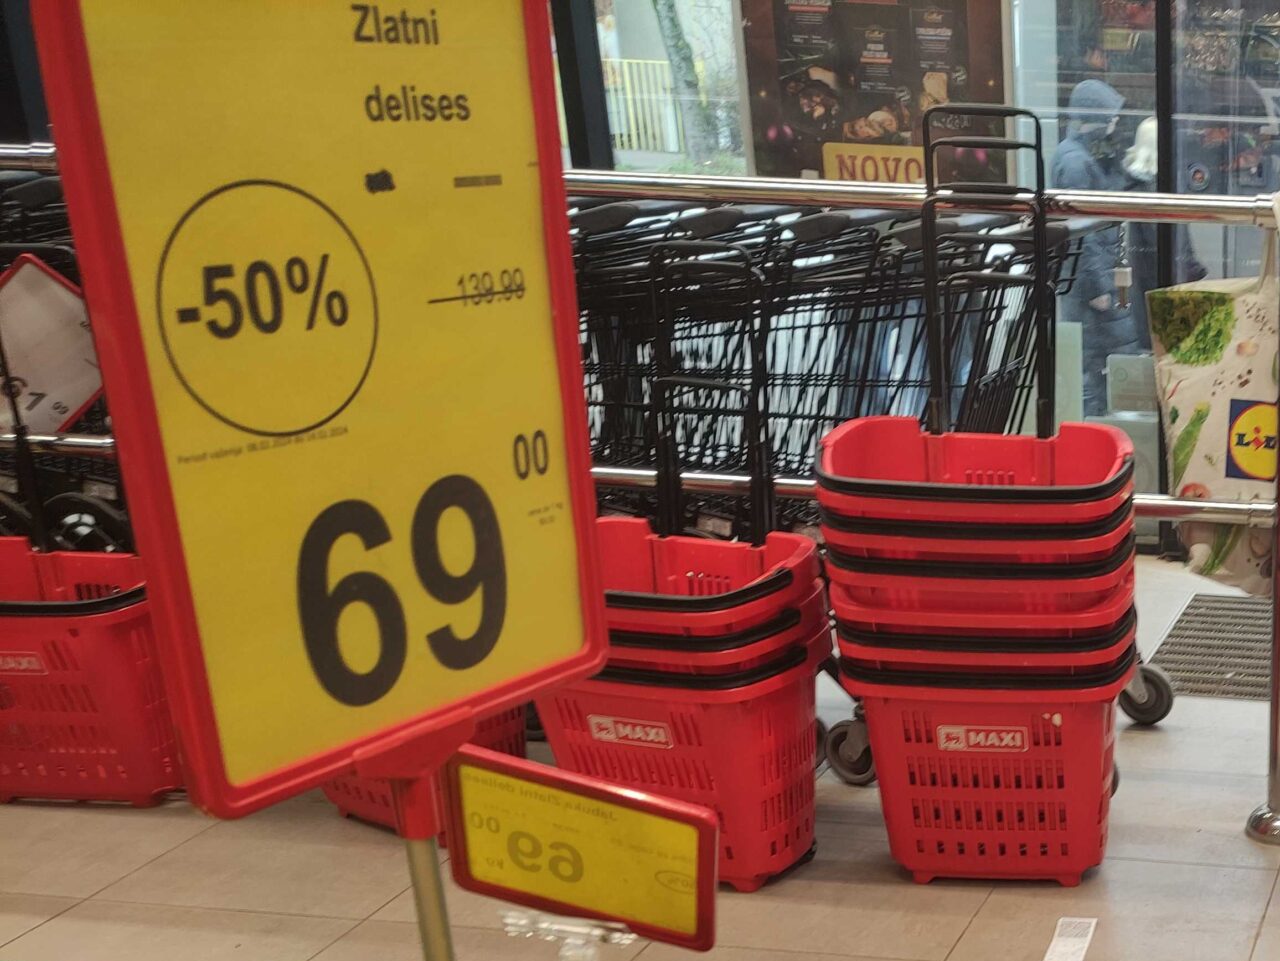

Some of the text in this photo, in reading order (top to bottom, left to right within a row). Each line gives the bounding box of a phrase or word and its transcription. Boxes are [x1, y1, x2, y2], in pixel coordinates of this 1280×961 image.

[351, 4, 440, 46] Zlatni
[365, 84, 471, 122] delises
[835, 154, 923, 183] NOVO
[176, 253, 349, 339] -50%
[513, 429, 549, 481] 00
[296, 473, 508, 708] 69
[616, 722, 667, 743] MAXI
[967, 731, 1022, 747] MAXI
